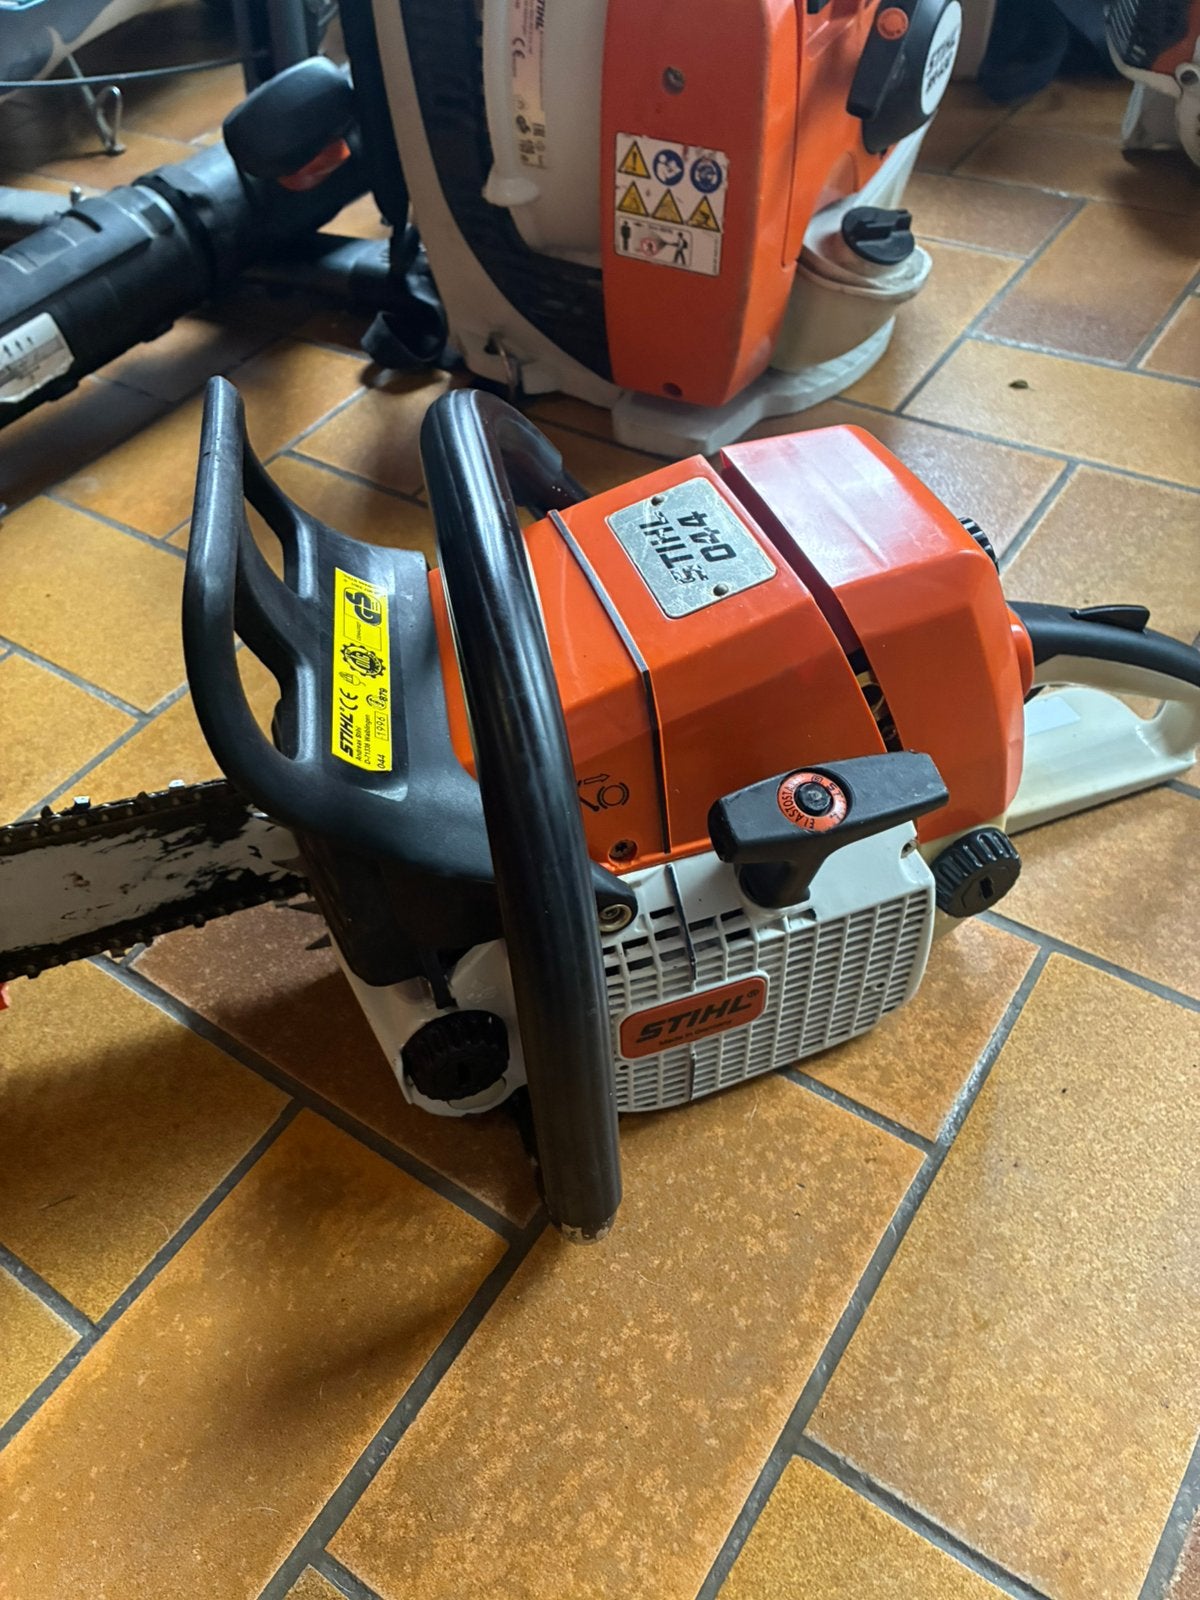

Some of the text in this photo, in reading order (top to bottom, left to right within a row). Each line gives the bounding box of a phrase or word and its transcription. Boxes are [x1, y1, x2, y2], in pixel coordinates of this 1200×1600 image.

[536, 0, 545, 30] TIHL
[639, 511, 709, 585] STIHL
[677, 511, 737, 563] 044
[376, 716, 386, 737] 1996
[377, 753, 386, 770] 044
